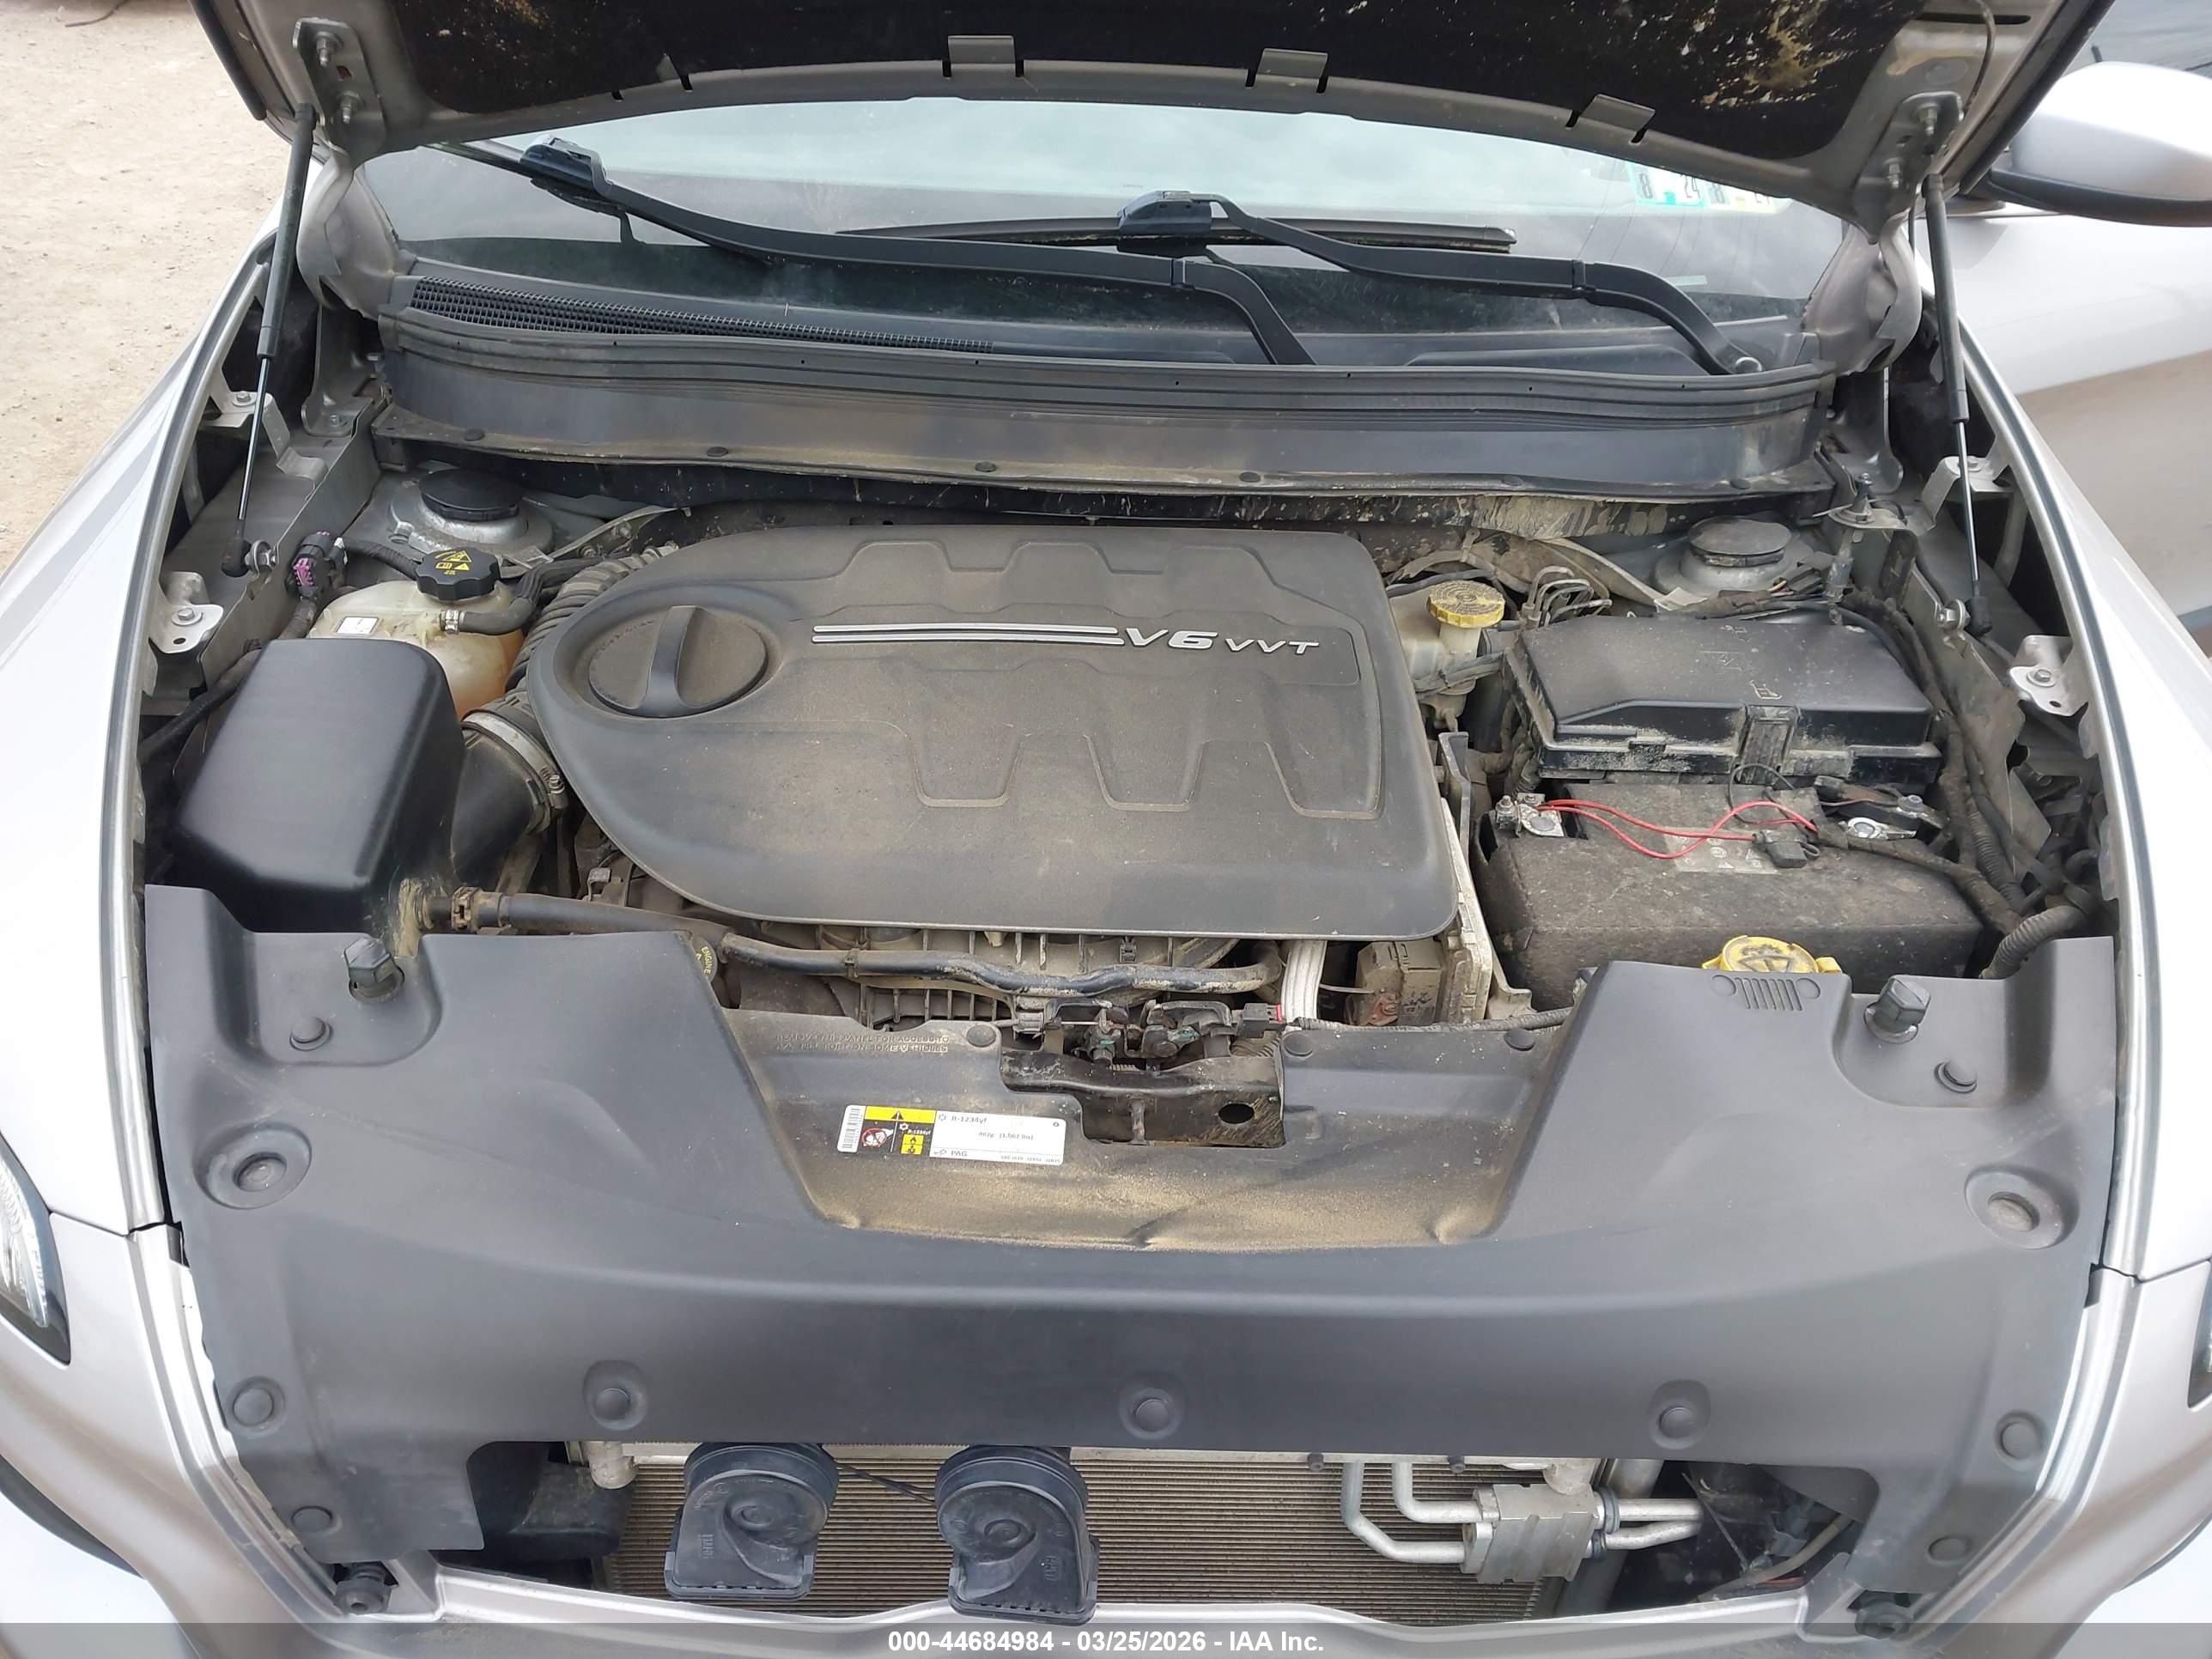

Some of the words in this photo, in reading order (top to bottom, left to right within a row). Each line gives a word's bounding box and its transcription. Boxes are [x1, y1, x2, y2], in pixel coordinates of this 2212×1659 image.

[1125, 628, 1219, 650] V6
[1225, 638, 1320, 655] VVT
[701, 946, 713, 975] ENGINE
[900, 1044, 949, 1053] VEHICLES
[951, 1115, 988, 1125] R-1234yf
